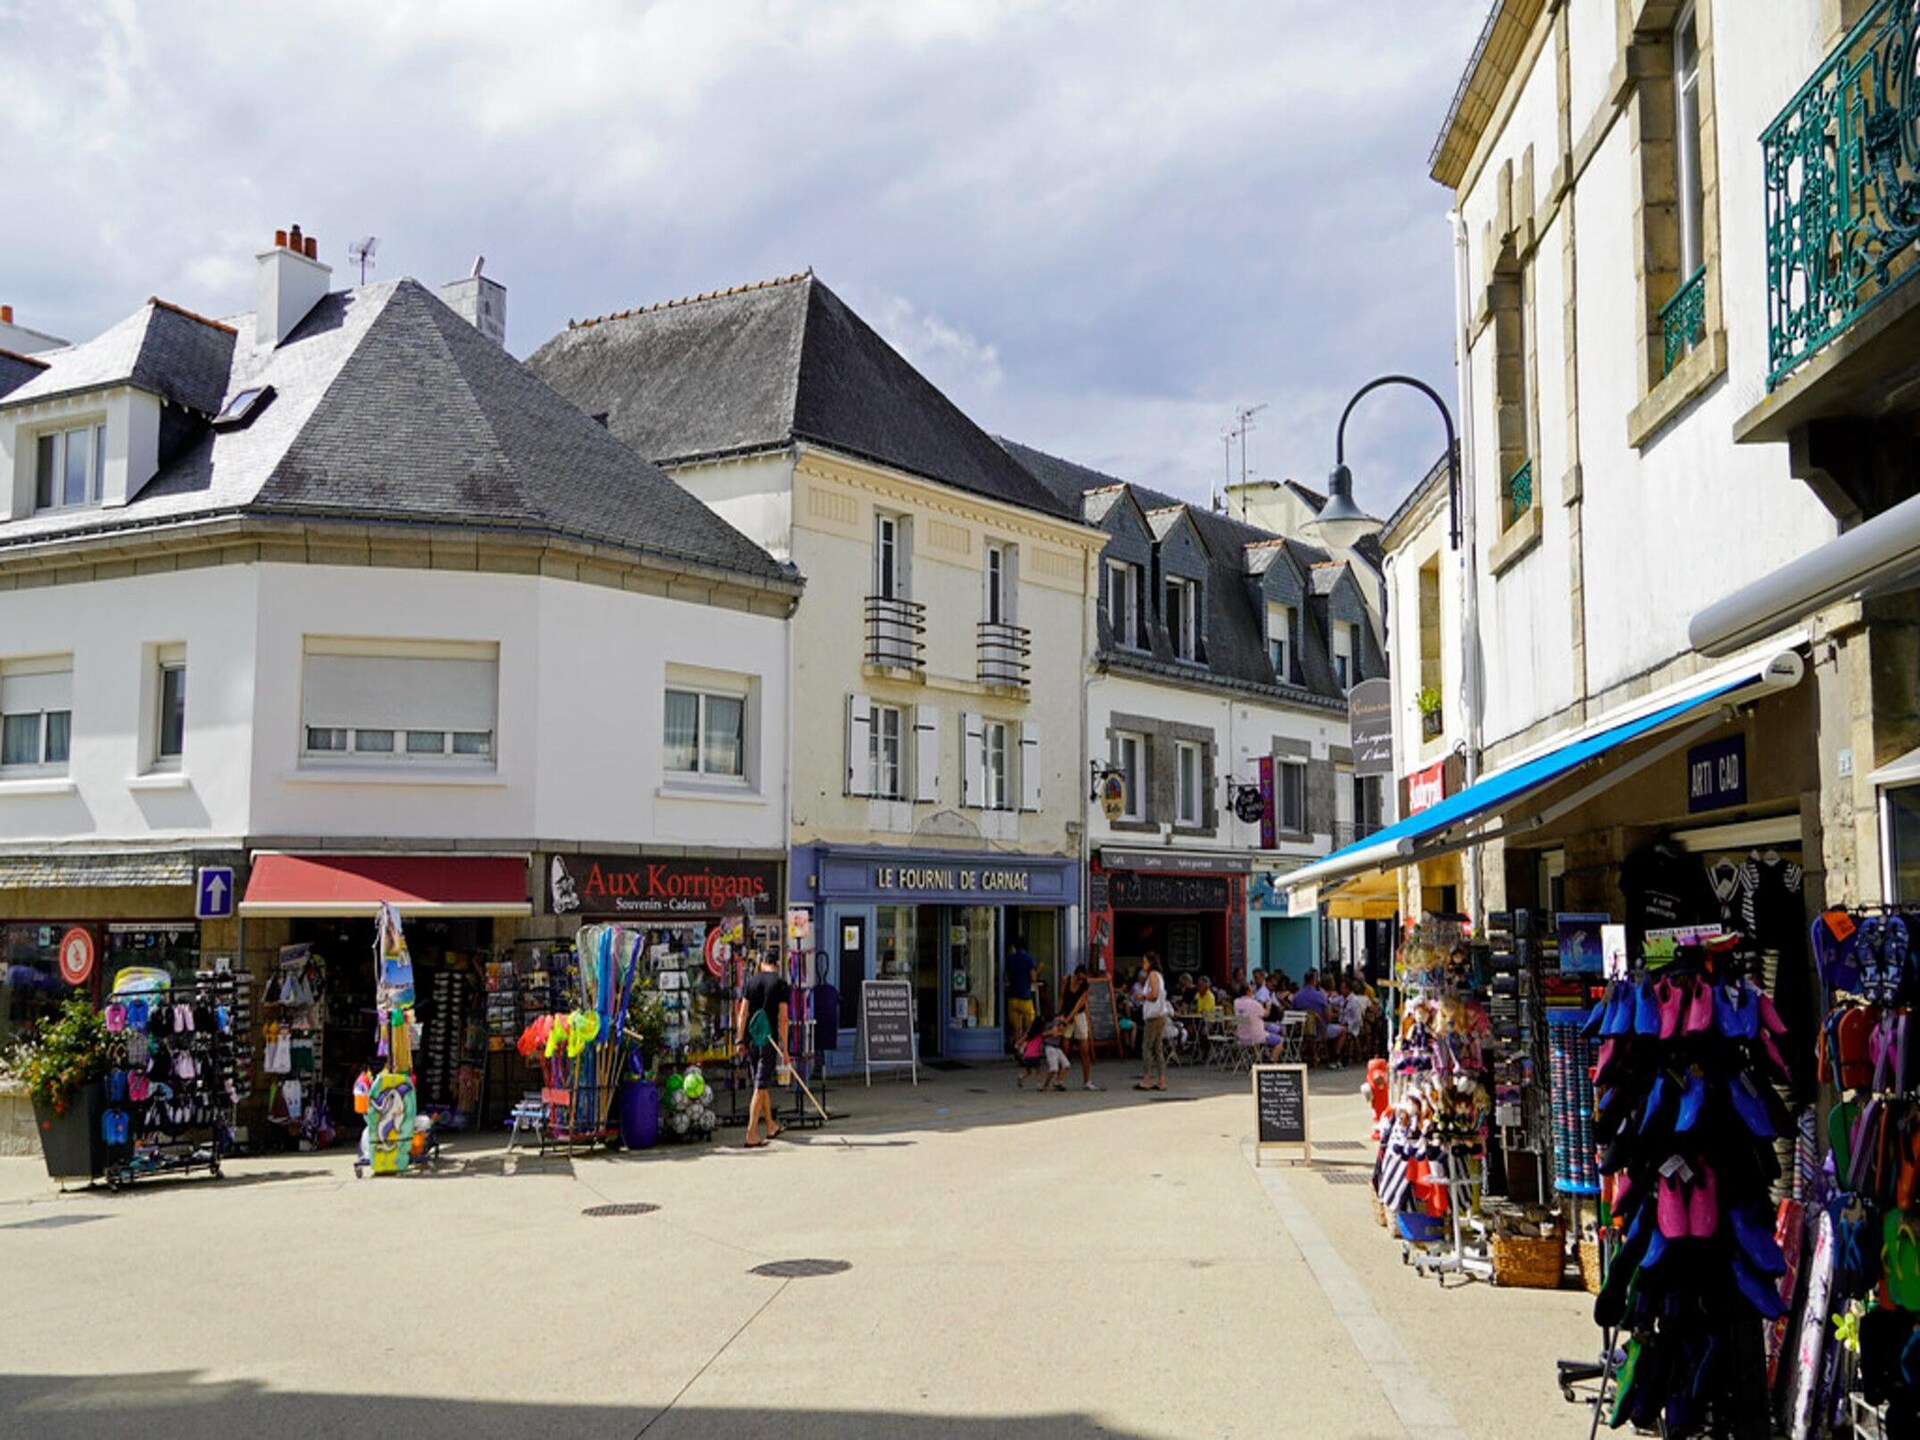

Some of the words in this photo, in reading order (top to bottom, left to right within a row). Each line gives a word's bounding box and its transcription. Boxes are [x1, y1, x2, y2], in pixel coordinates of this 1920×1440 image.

[1691, 761, 1712, 798] ARTI
[1719, 753, 1739, 792] CAD
[584, 862, 639, 896] Aux
[647, 864, 764, 908] Korrigans
[878, 868, 893, 888] LE
[899, 868, 954, 890] FOURNIL
[960, 871, 976, 890] DE
[982, 871, 1028, 891] CARNAC
[616, 897, 661, 910] Souvenirs
[669, 898, 707, 911] Cadeaux
